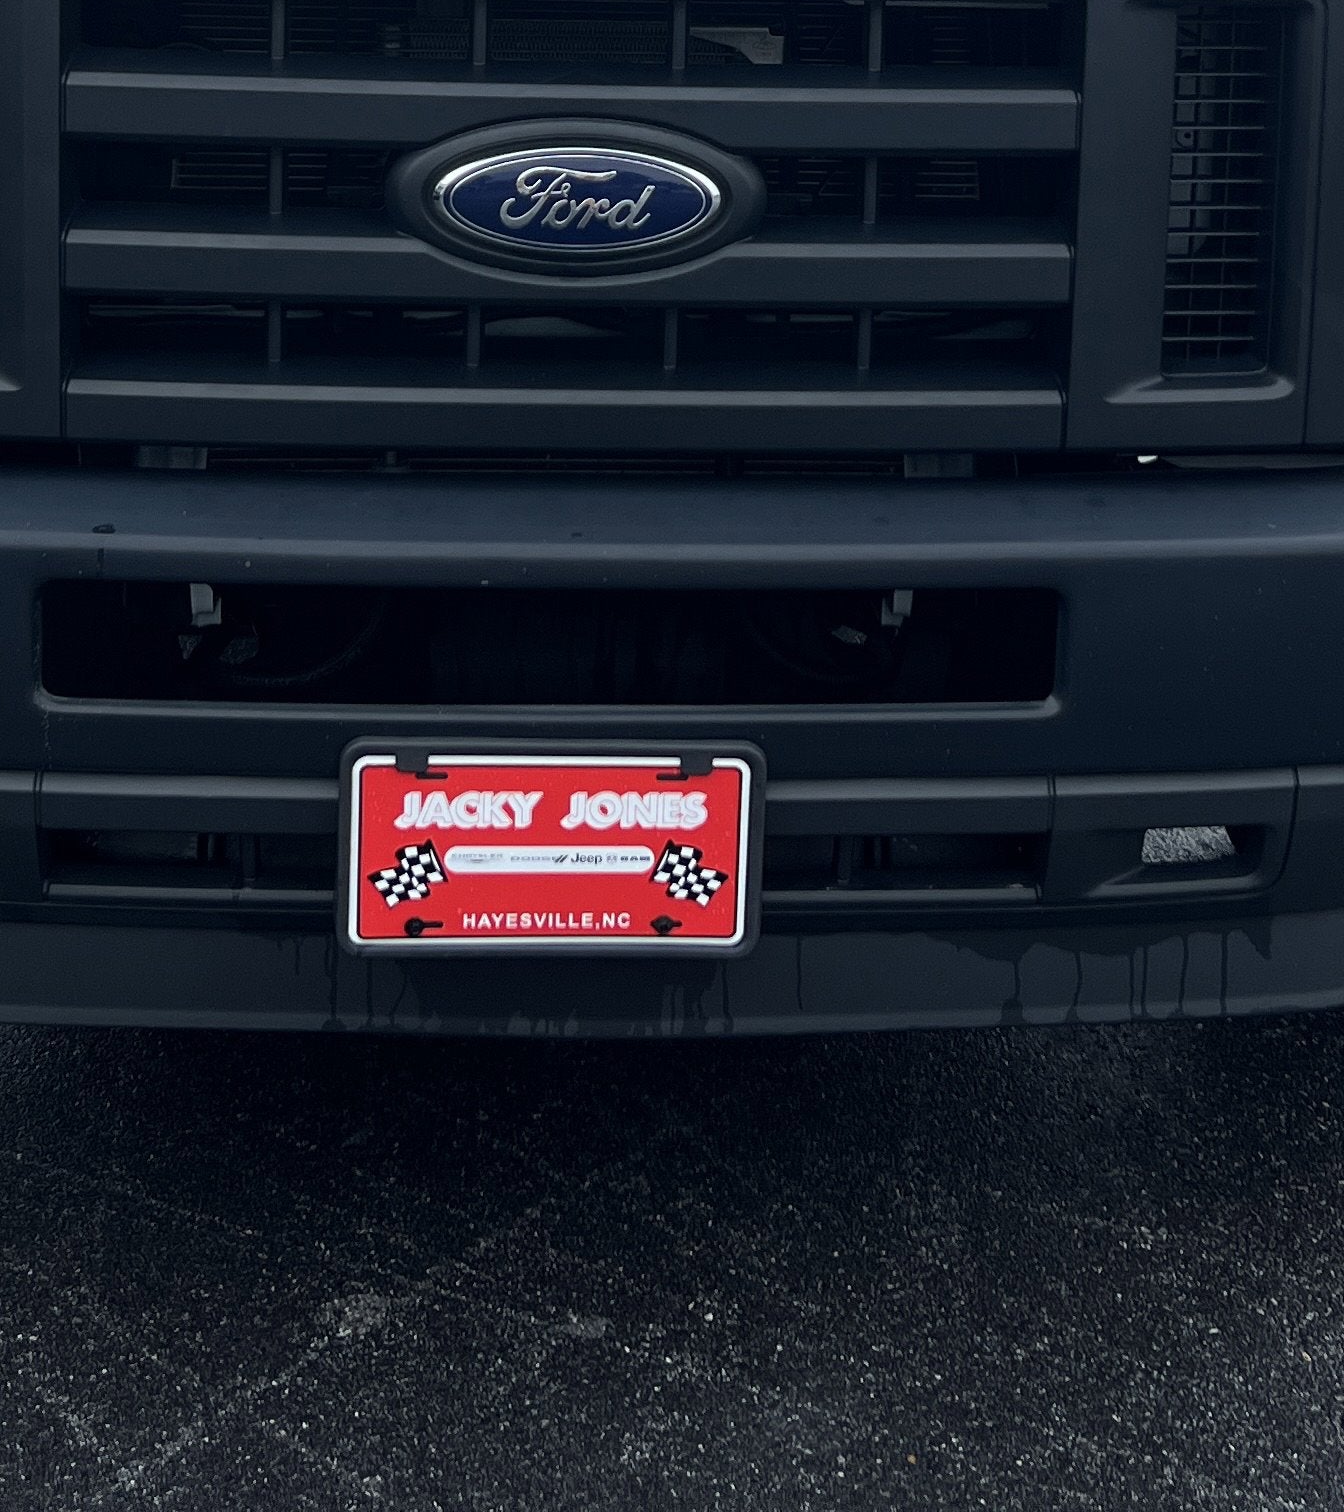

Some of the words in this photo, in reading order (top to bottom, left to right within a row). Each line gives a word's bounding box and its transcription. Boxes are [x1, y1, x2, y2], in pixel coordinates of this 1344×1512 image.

[499, 166, 656, 230] Ford
[394, 791, 543, 830] JACKY
[560, 791, 709, 830] JONES
[570, 852, 603, 865] Jeep
